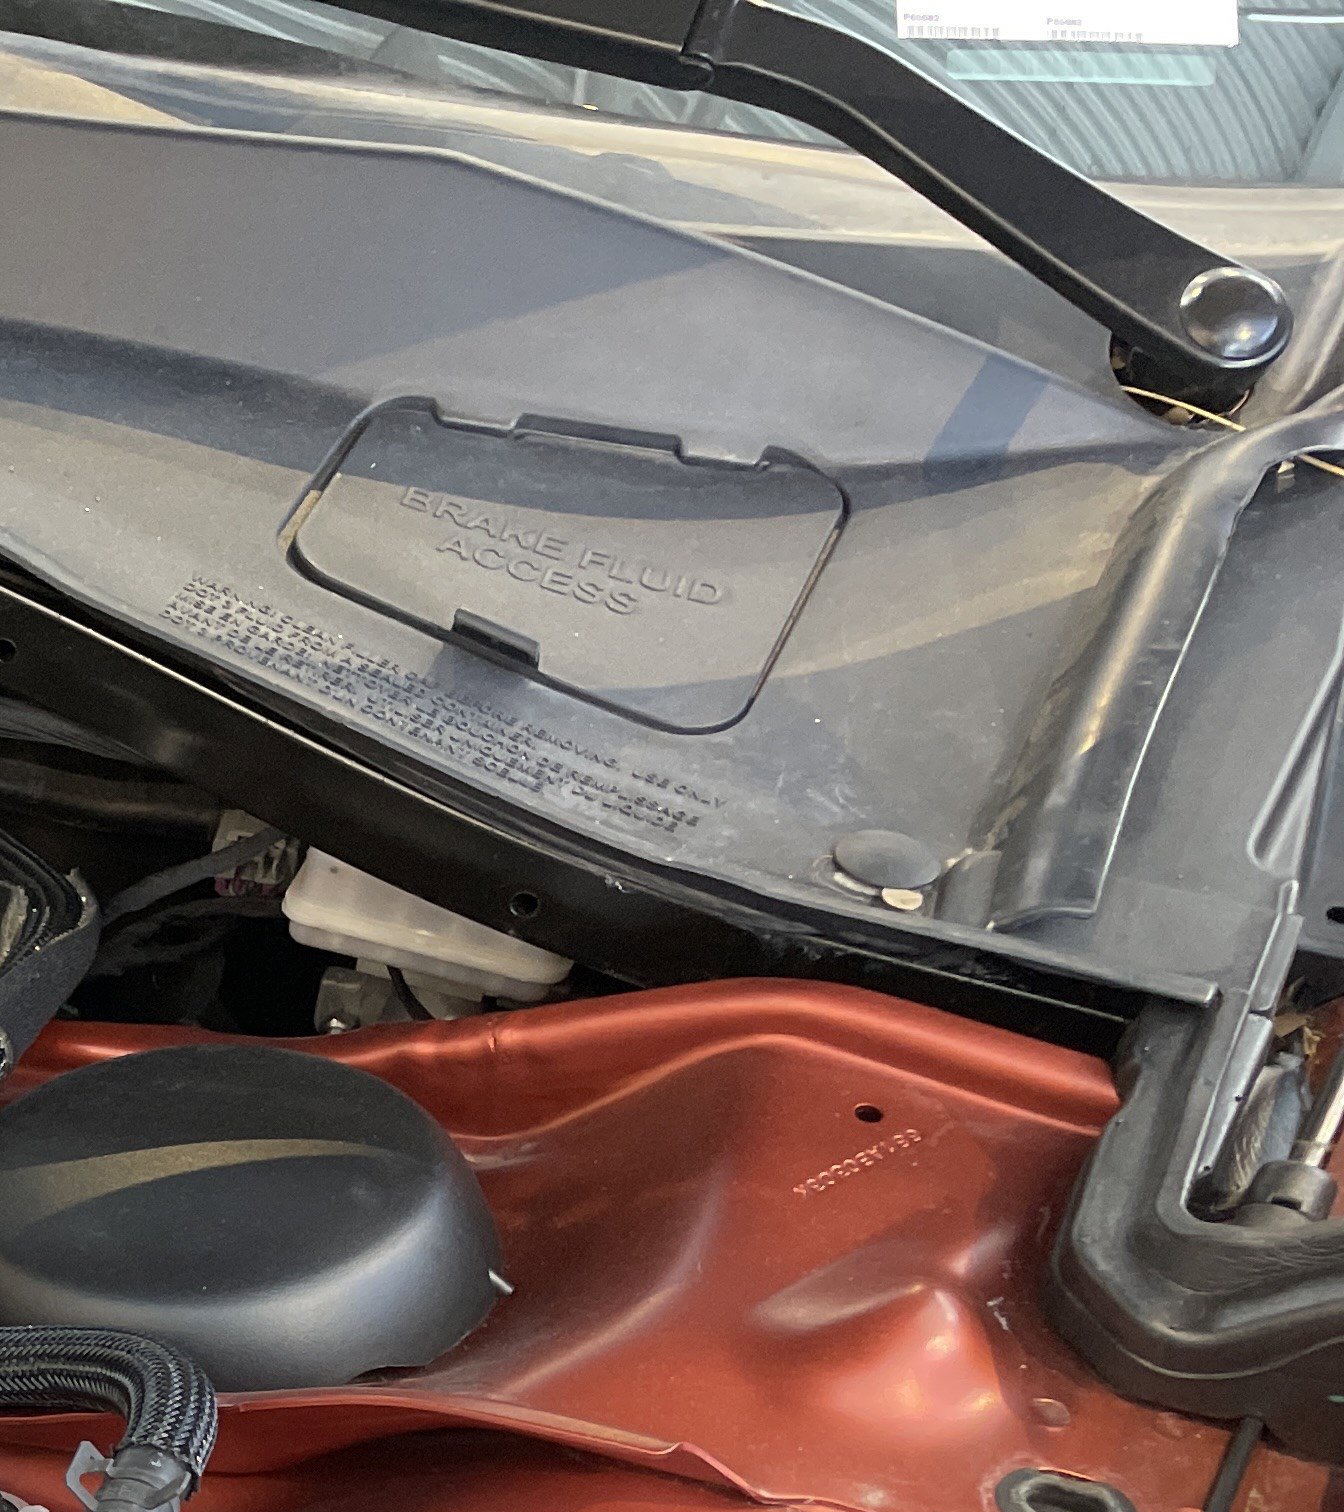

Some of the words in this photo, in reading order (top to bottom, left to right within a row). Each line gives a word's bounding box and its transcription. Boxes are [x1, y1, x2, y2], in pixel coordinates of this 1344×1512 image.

[398, 486, 569, 559] BRAKE
[580, 547, 723, 606] FLUID
[437, 534, 640, 616] ACCESS
[182, 582, 221, 603] DOT
[338, 655, 353, 665] A
[356, 662, 426, 698] SEALED
